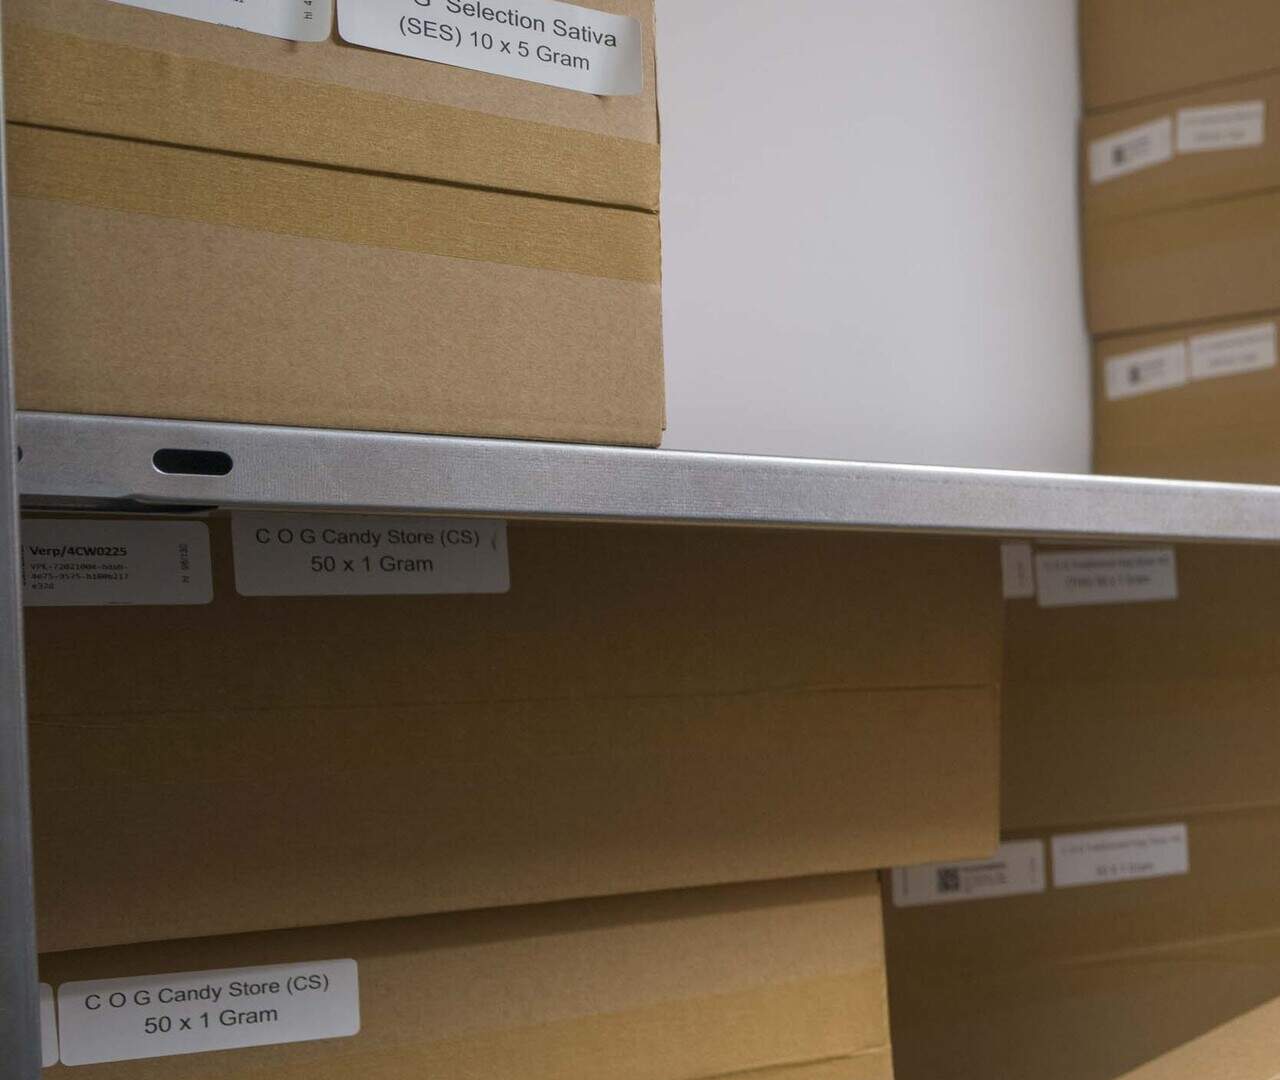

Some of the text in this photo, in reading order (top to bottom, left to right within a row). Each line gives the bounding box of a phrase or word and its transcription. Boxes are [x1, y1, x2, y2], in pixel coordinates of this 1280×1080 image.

[447, 0, 617, 47] Selection Sativa
[399, 16, 590, 71] (SES) 10 x 5 Gram
[256, 528, 480, 548] C O G Candy Store (CS)
[29, 545, 128, 558] Verp/4CW0225
[311, 556, 433, 572] 50 x 1 Gram
[85, 974, 329, 1010] C O G Candy Store (CS)
[145, 1008, 278, 1034] 50 x 1 Gram
